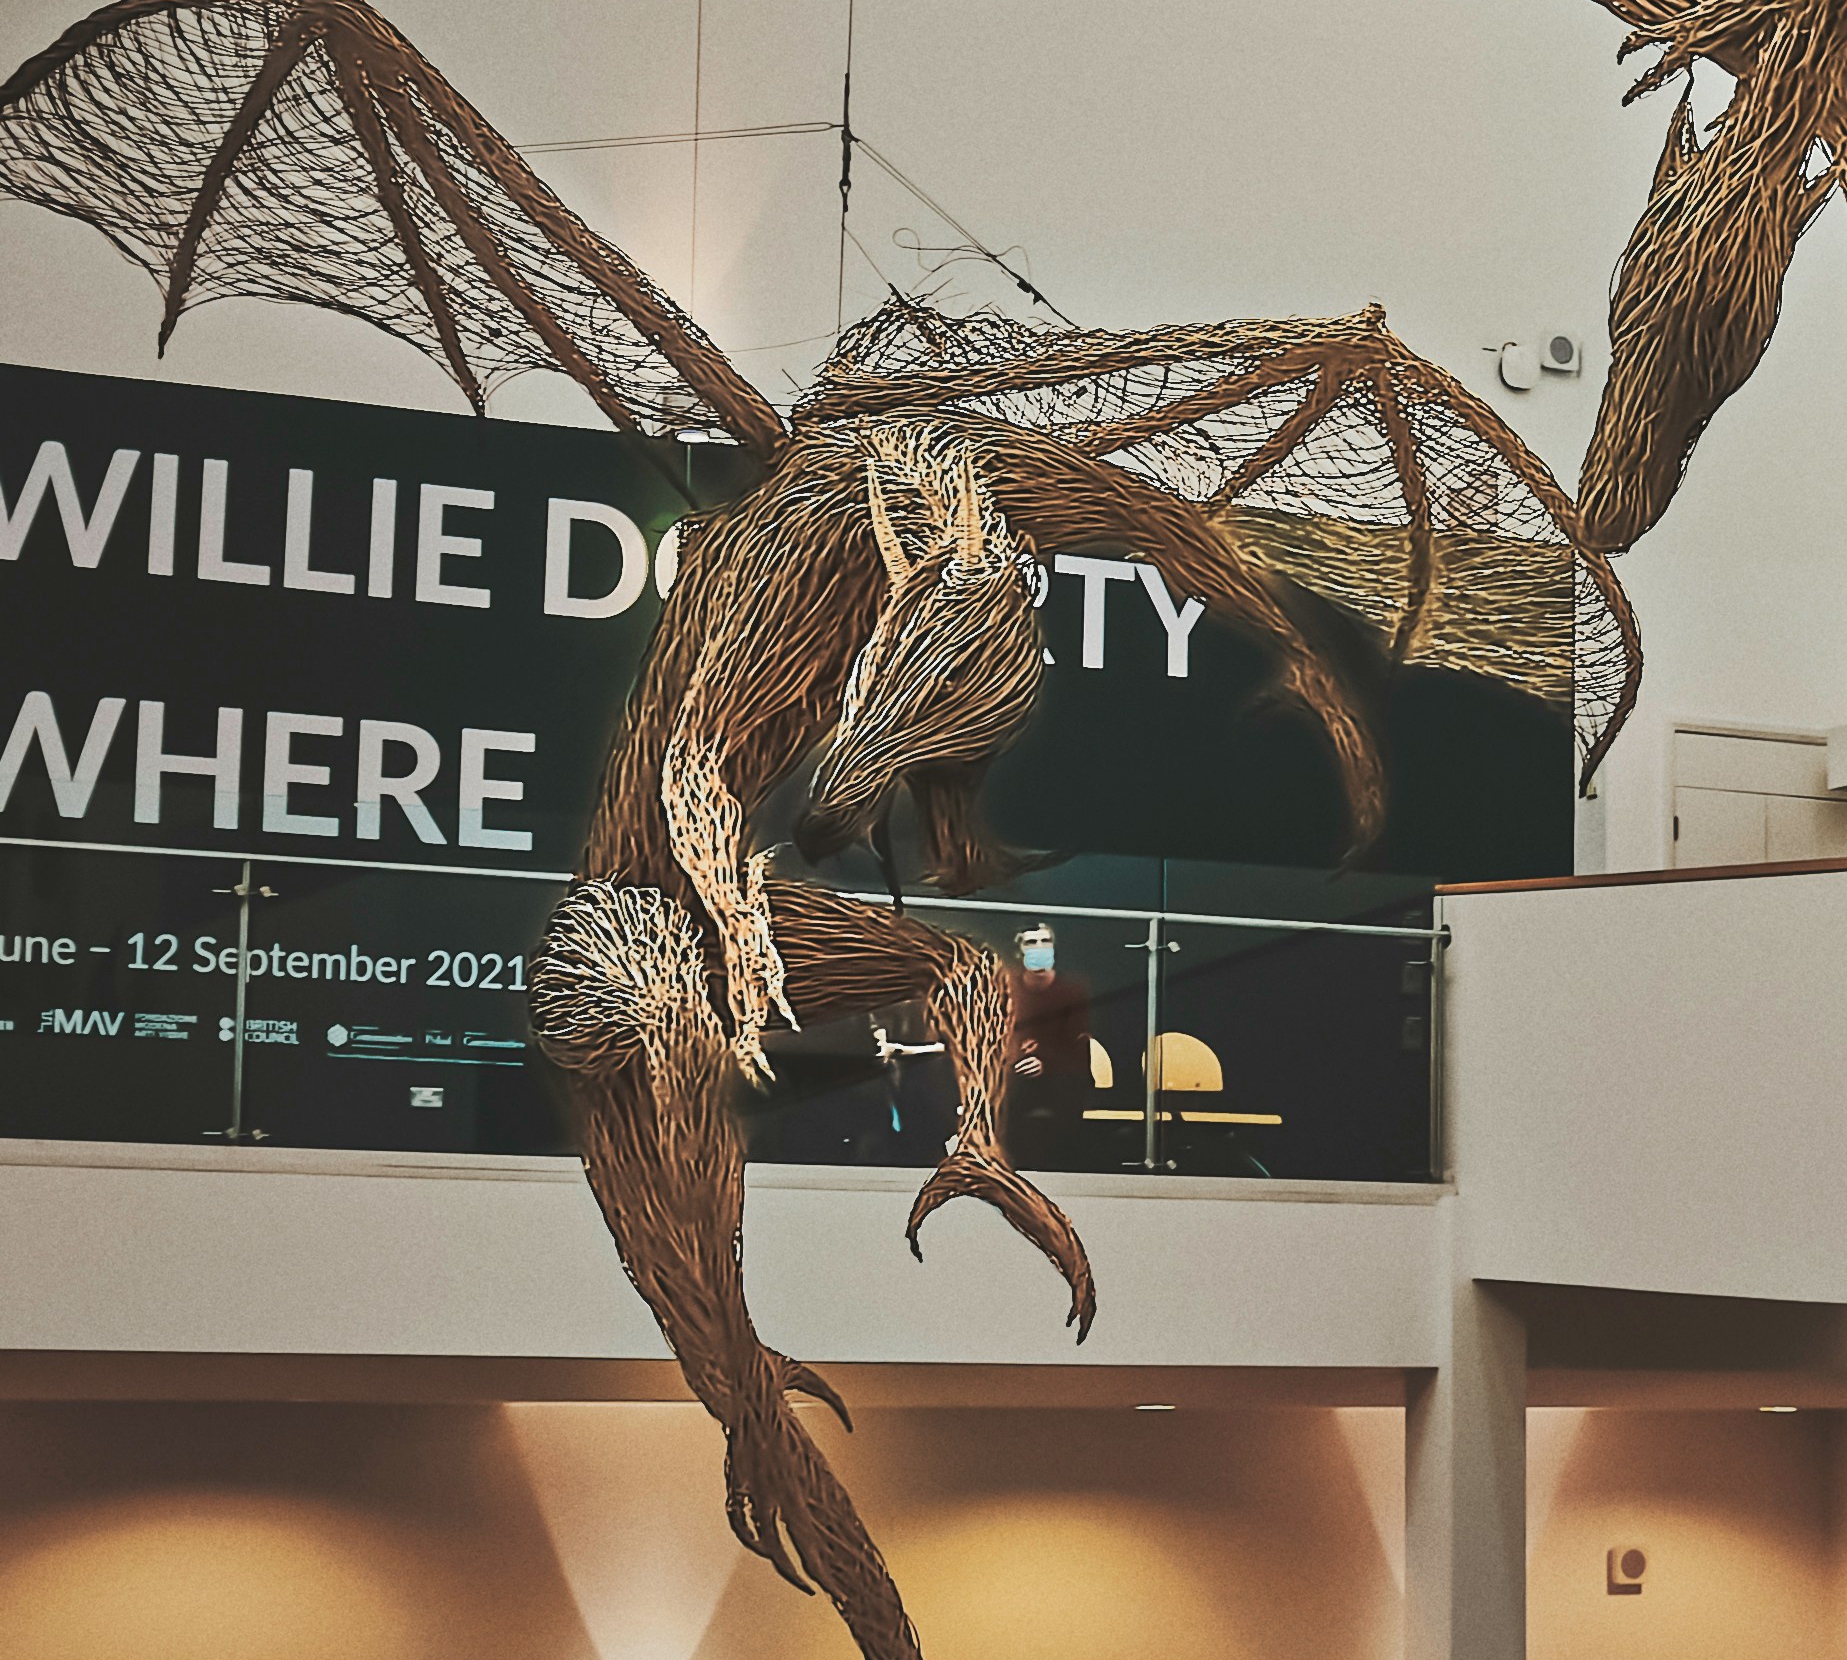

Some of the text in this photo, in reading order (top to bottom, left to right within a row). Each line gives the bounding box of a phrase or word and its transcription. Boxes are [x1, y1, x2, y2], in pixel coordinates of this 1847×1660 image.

[0, 440, 495, 609] WILLIE
[0, 690, 536, 852] WHERE
[127, 931, 179, 971] 12
[192, 936, 416, 984] September
[425, 950, 527, 991] 2021
